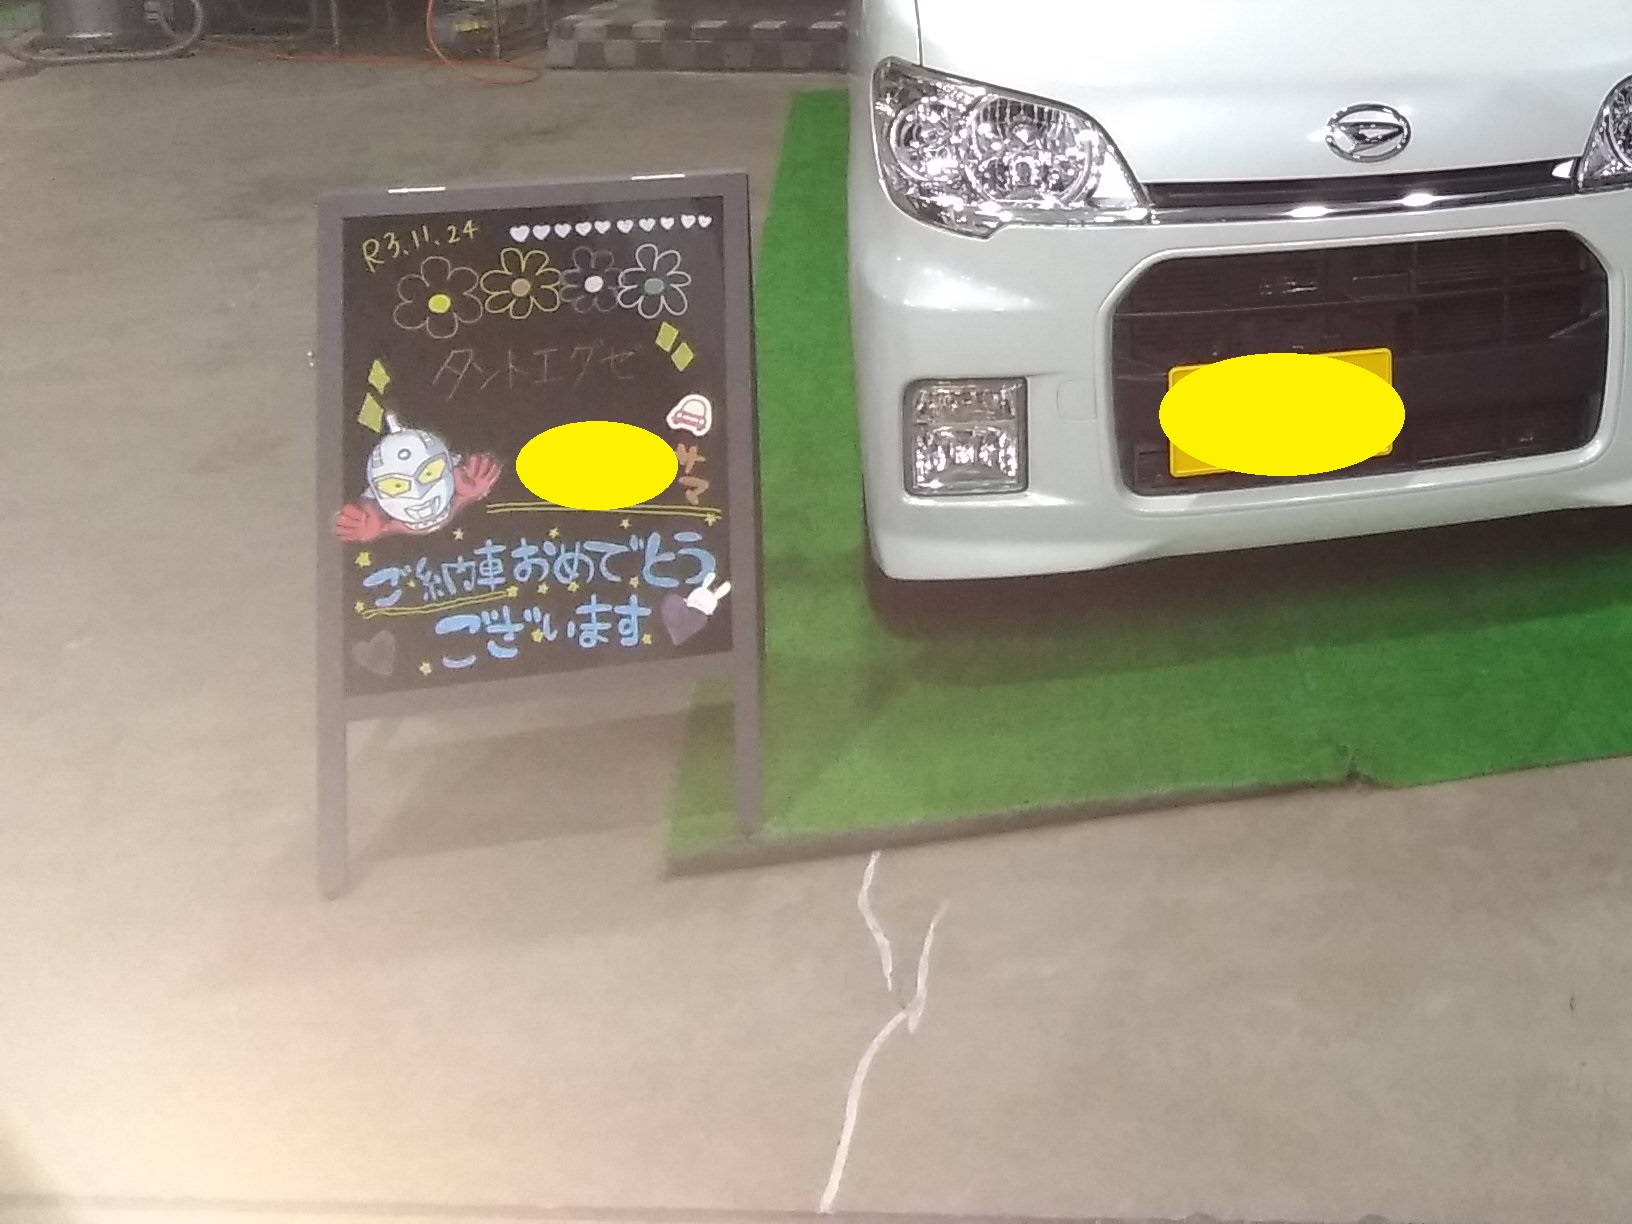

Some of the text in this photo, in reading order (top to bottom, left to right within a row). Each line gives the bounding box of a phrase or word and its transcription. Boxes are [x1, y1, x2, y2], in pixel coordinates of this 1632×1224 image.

[362, 219, 479, 273] R3.11.24
[363, 530, 717, 608] ご納車おめでとう
[435, 593, 653, 669] ございます
